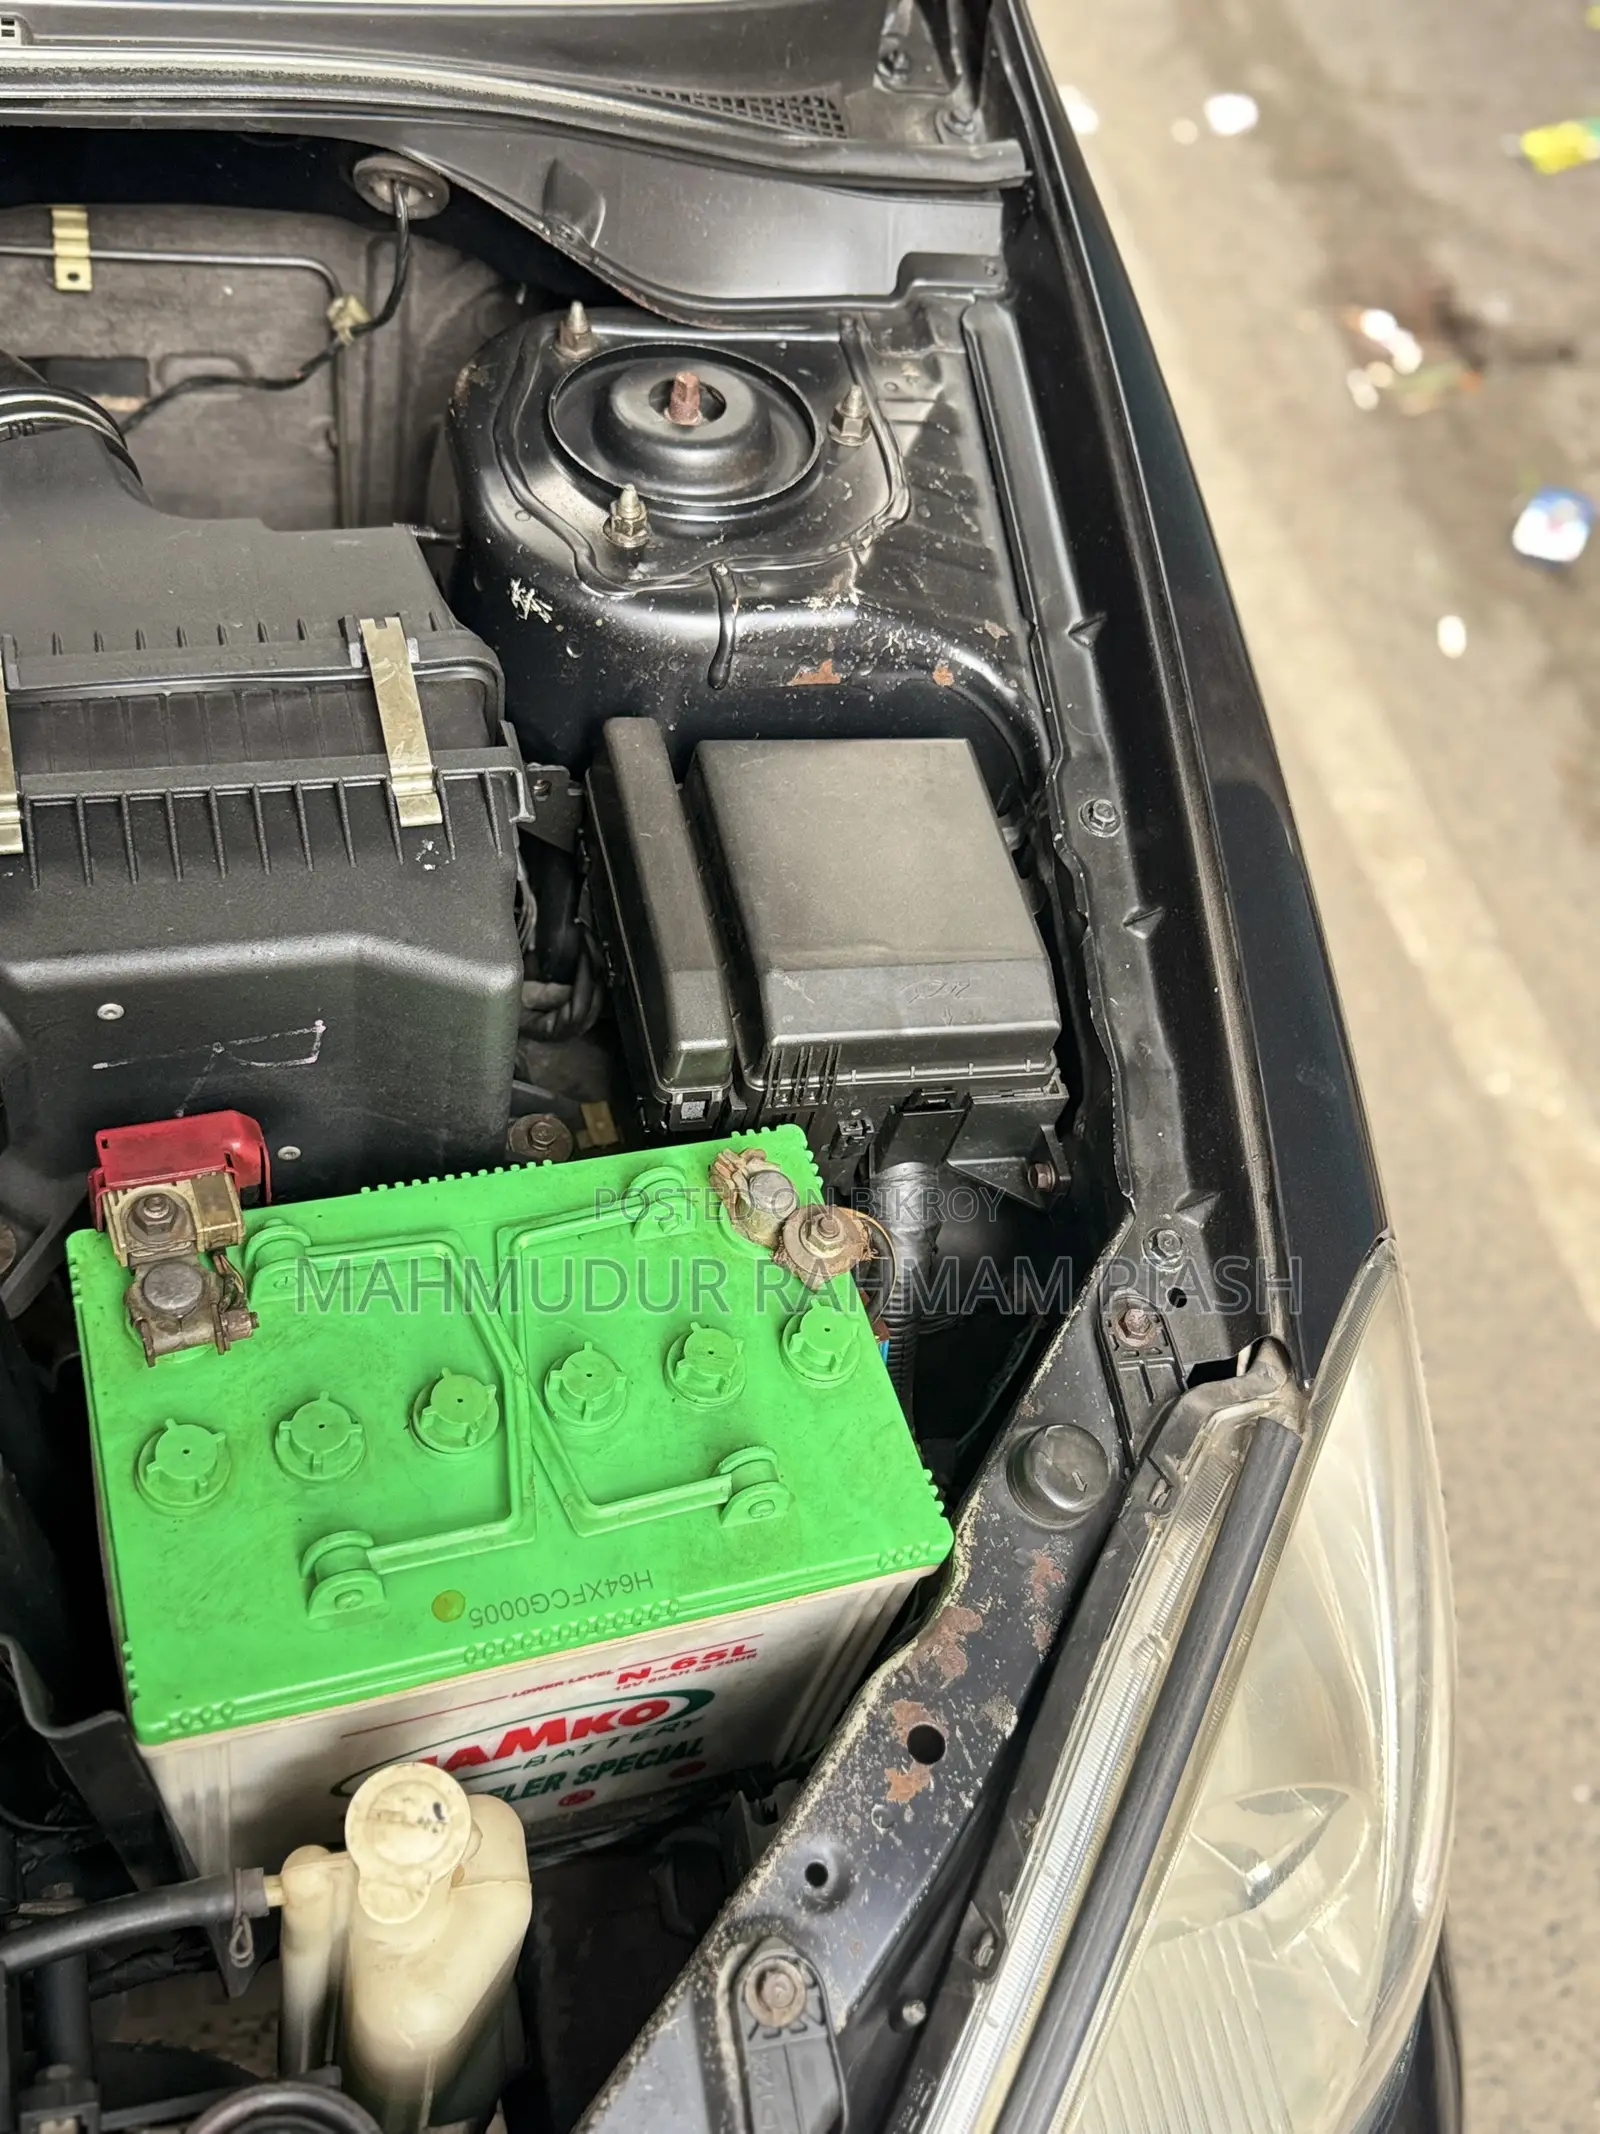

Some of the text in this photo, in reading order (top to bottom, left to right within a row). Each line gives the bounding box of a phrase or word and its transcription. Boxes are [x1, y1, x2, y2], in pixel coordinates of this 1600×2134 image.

[469, 1569, 654, 1629] H64XFCG0005
[511, 1669, 615, 1698] LOWER LEVEL
[616, 1644, 758, 1685] N-65L
[418, 1698, 671, 1772] AMKO
[521, 1715, 706, 1770] BATTERY
[573, 1736, 705, 1787] SPECIAL
